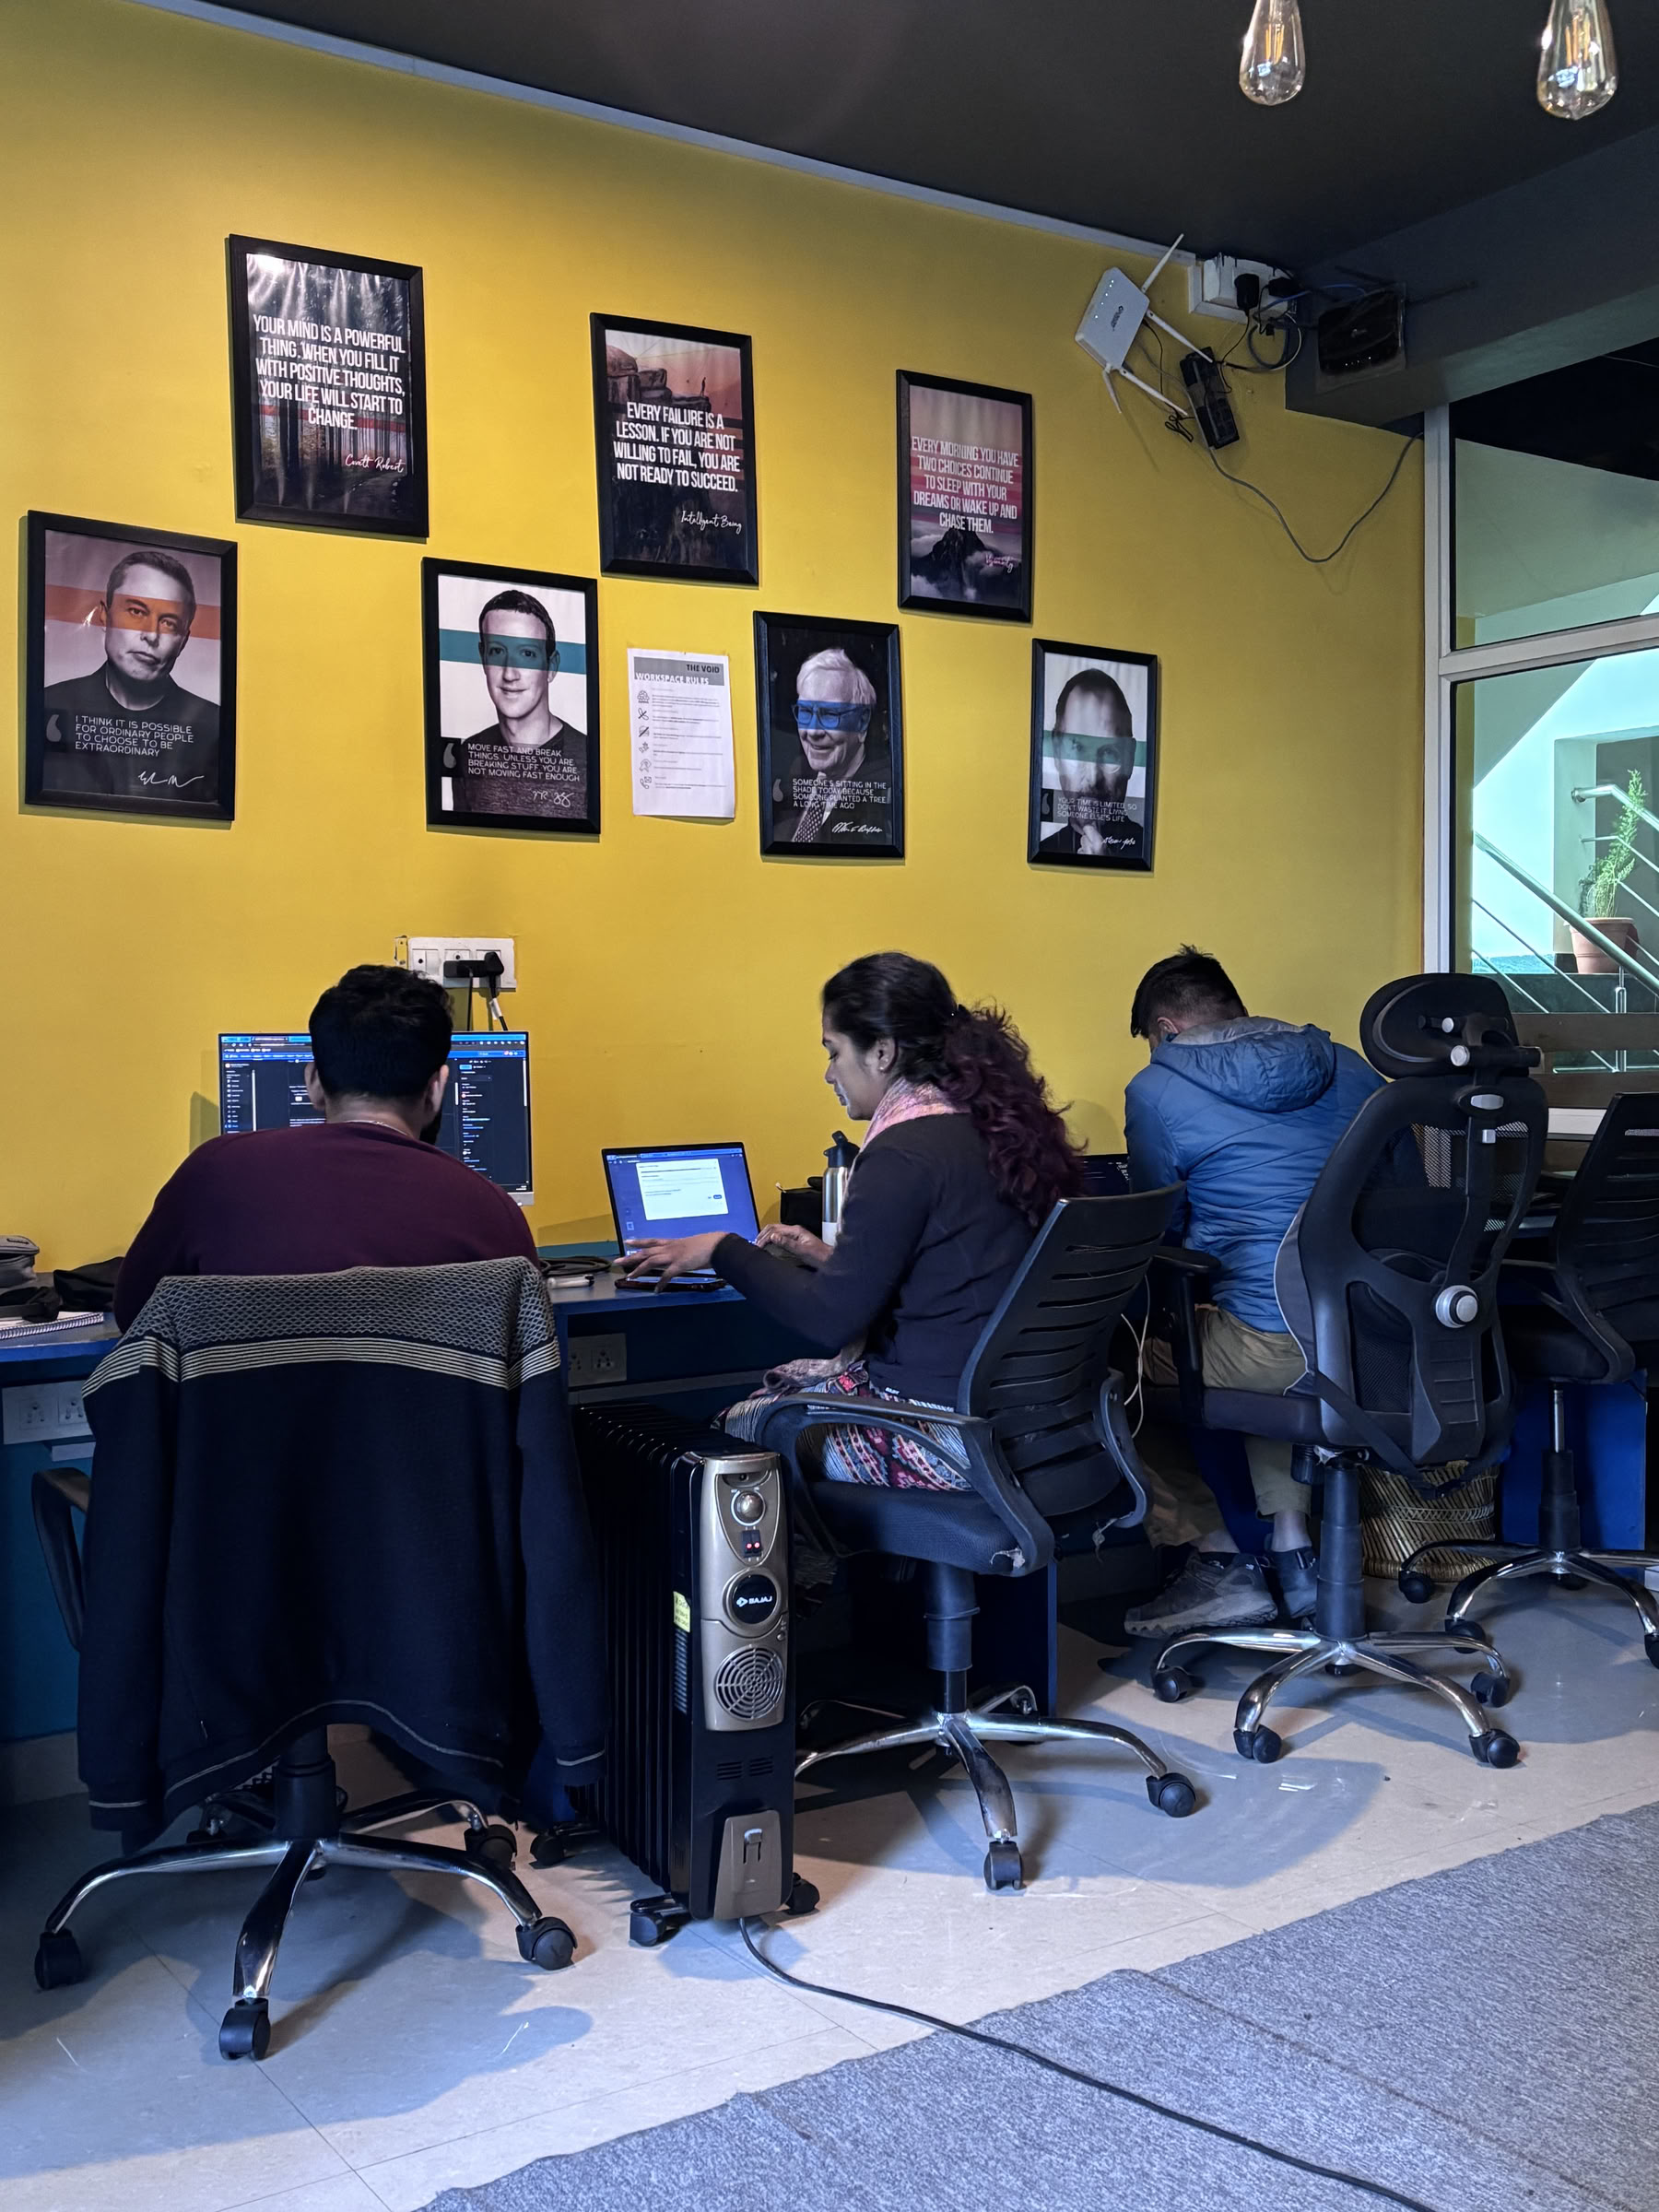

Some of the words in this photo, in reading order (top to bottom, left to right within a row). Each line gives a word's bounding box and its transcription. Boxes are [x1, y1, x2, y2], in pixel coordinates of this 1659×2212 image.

[253, 314, 285, 335] YOUR
[288, 320, 318, 339] MIND
[321, 324, 331, 342] IS
[335, 327, 342, 344] A
[345, 328, 406, 353] POWERFUL
[301, 343, 337, 364] WHEN
[339, 348, 361, 367] YOU
[365, 352, 387, 371] FILL
[390, 356, 399, 372] IT
[256, 359, 288, 378] WITH
[290, 362, 342, 385] POSITIVE
[344, 370, 405, 396] THOUGHTS,
[260, 380, 291, 399] YOUR
[295, 384, 319, 403] LIFE
[322, 388, 349, 407] WILL
[351, 393, 386, 412] START
[389, 397, 403, 415] TO
[308, 407, 358, 429] CHANGE.
[627, 402, 661, 421] EVERY
[664, 406, 703, 427] FAILURE
[706, 412, 714, 429] IS
[716, 414, 724, 429] A
[617, 421, 659, 441] LESSON.
[662, 427, 671, 442] IF
[672, 429, 691, 445] YOU
[694, 431, 713, 449] ARE
[716, 434, 735, 451] NOT
[614, 441, 655, 462] WILLING
[657, 447, 671, 465] TO
[673, 449, 697, 468] FAIL,
[699, 452, 718, 469] YOU
[721, 454, 740, 472] ARE
[912, 436, 938, 453] EVERY
[940, 441, 978, 460] MORNING
[981, 448, 996, 463] YOU
[998, 451, 1019, 467] HAVE
[618, 463, 638, 480] NOT
[641, 465, 674, 485] READY
[676, 470, 688, 487] TO
[691, 472, 737, 492] SUCCEED.
[917, 455, 935, 472] TWO
[938, 460, 971, 477] CHOICES
[974, 467, 1013, 484] CONTINUE
[924, 475, 935, 488] TO
[937, 477, 961, 492] SLEEP
[963, 481, 984, 497] WITH
[986, 484, 1006, 500] YOUR
[914, 491, 948, 510] DREAMS
[951, 498, 961, 511] OR
[962, 499, 987, 514] WAKE
[989, 502, 999, 516] UP
[1000, 505, 1017, 519] AND
[940, 512, 965, 530] CHASE
[967, 517, 994, 534] THEM.
[635, 673, 684, 684] WORKSPACE
[686, 676, 709, 685] RULES
[76, 724, 96, 733] FOR
[100, 726, 150, 738] ORDINARY
[155, 732, 194, 743] PEOPLE
[82, 716, 112, 726] THINK
[129, 721, 138, 729] IS
[142, 722, 192, 735] POSSIBLE
[76, 733, 91, 741] TO
[94, 735, 138, 747] CHOOSE
[142, 739, 157, 747] TO
[160, 741, 173, 749] BE
[76, 742, 159, 757] EXTRAORDINARY
[468, 743, 490, 752] MOVE
[535, 748, 561, 757] BREAK
[468, 759, 509, 769] BREAKING
[562, 766, 577, 774] ARE
[503, 755, 536, 763] UNLESS
[488, 770, 521, 778] MOVING
[546, 773, 580, 782] ENOUGH
